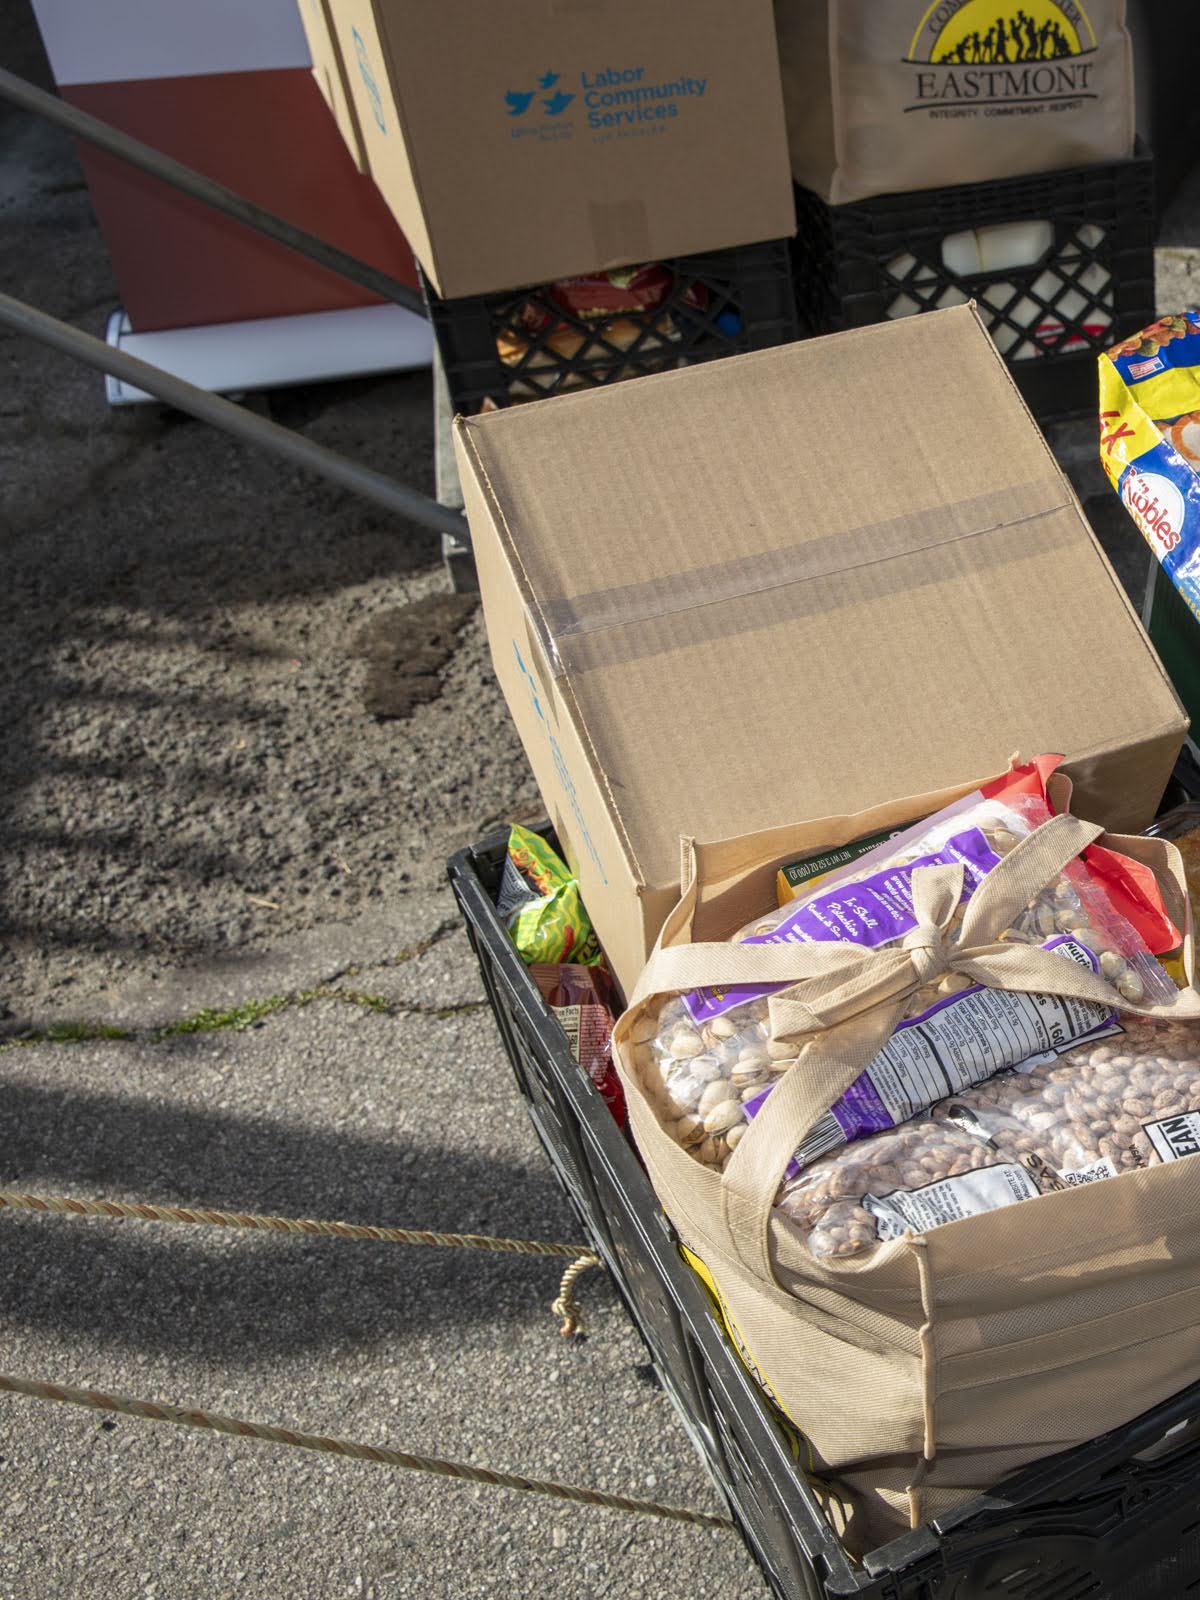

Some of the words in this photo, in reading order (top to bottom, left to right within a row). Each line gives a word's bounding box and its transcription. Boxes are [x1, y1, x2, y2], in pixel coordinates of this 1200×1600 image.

[580, 67, 645, 89] Labor
[915, 63, 1094, 99] EASTMONT
[584, 77, 708, 109] Community
[587, 103, 678, 130] Services
[929, 109, 979, 120] INTEGRITY
[984, 105, 1045, 117] COMMITMENT
[810, 860, 820, 874] OZ
[818, 856, 832, 870] 3.52
[831, 854, 841, 865] WT
[840, 850, 852, 862] NET
[797, 863, 812, 880] (100
[806, 903, 826, 924] Roasted
[826, 902, 859, 937] Pistachios
[843, 897, 880, 929] In-Shell
[1065, 943, 1091, 969] Nutri
[964, 996, 979, 1016] Sodium
[973, 991, 992, 1021] Cholesterol
[963, 1011, 986, 1048] Carbohydrate
[1049, 1021, 1066, 1046] 160
